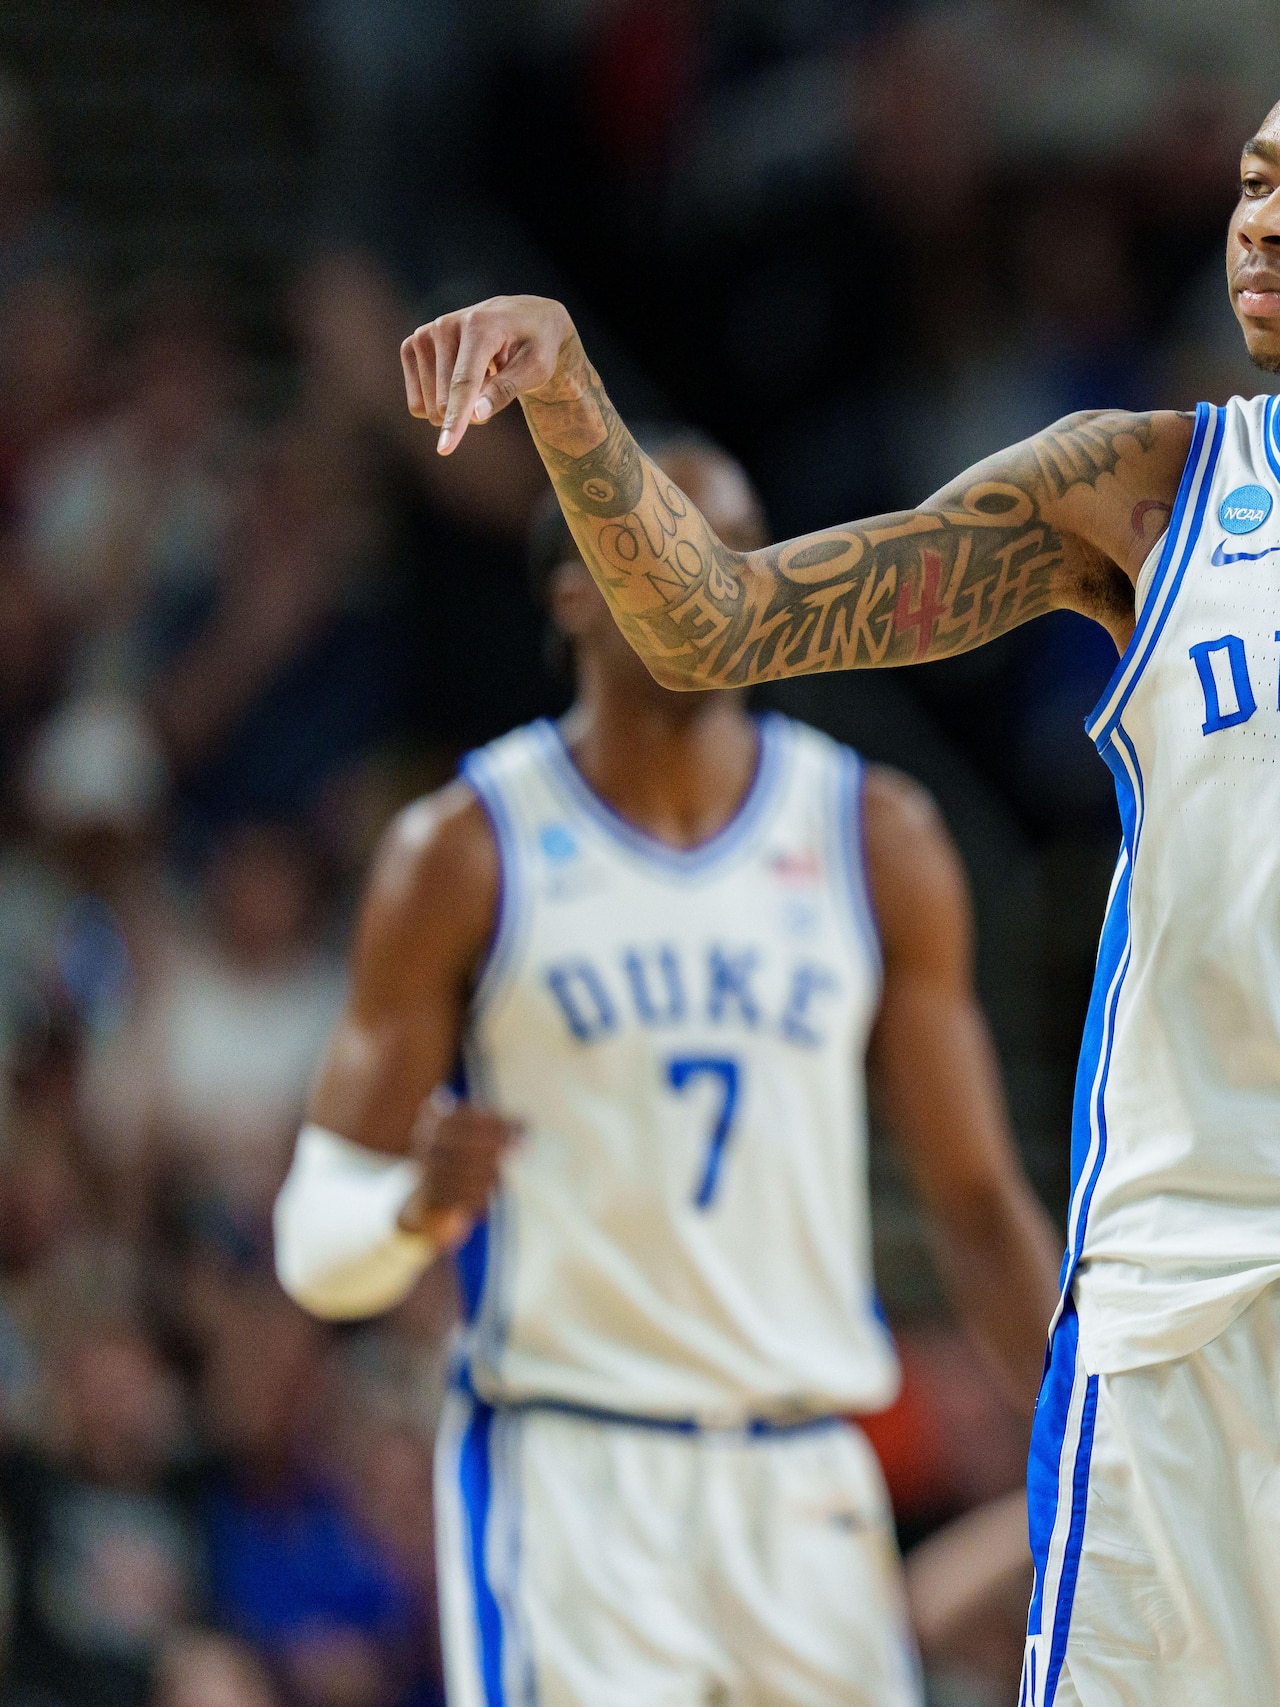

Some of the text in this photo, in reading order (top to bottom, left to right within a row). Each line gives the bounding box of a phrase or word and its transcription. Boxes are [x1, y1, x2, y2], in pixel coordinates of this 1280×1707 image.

[1224, 507, 1264, 521] NCAA
[893, 550, 947, 663] 4
[545, 944, 840, 1050] DUKE
[667, 1052, 740, 1216] 7
